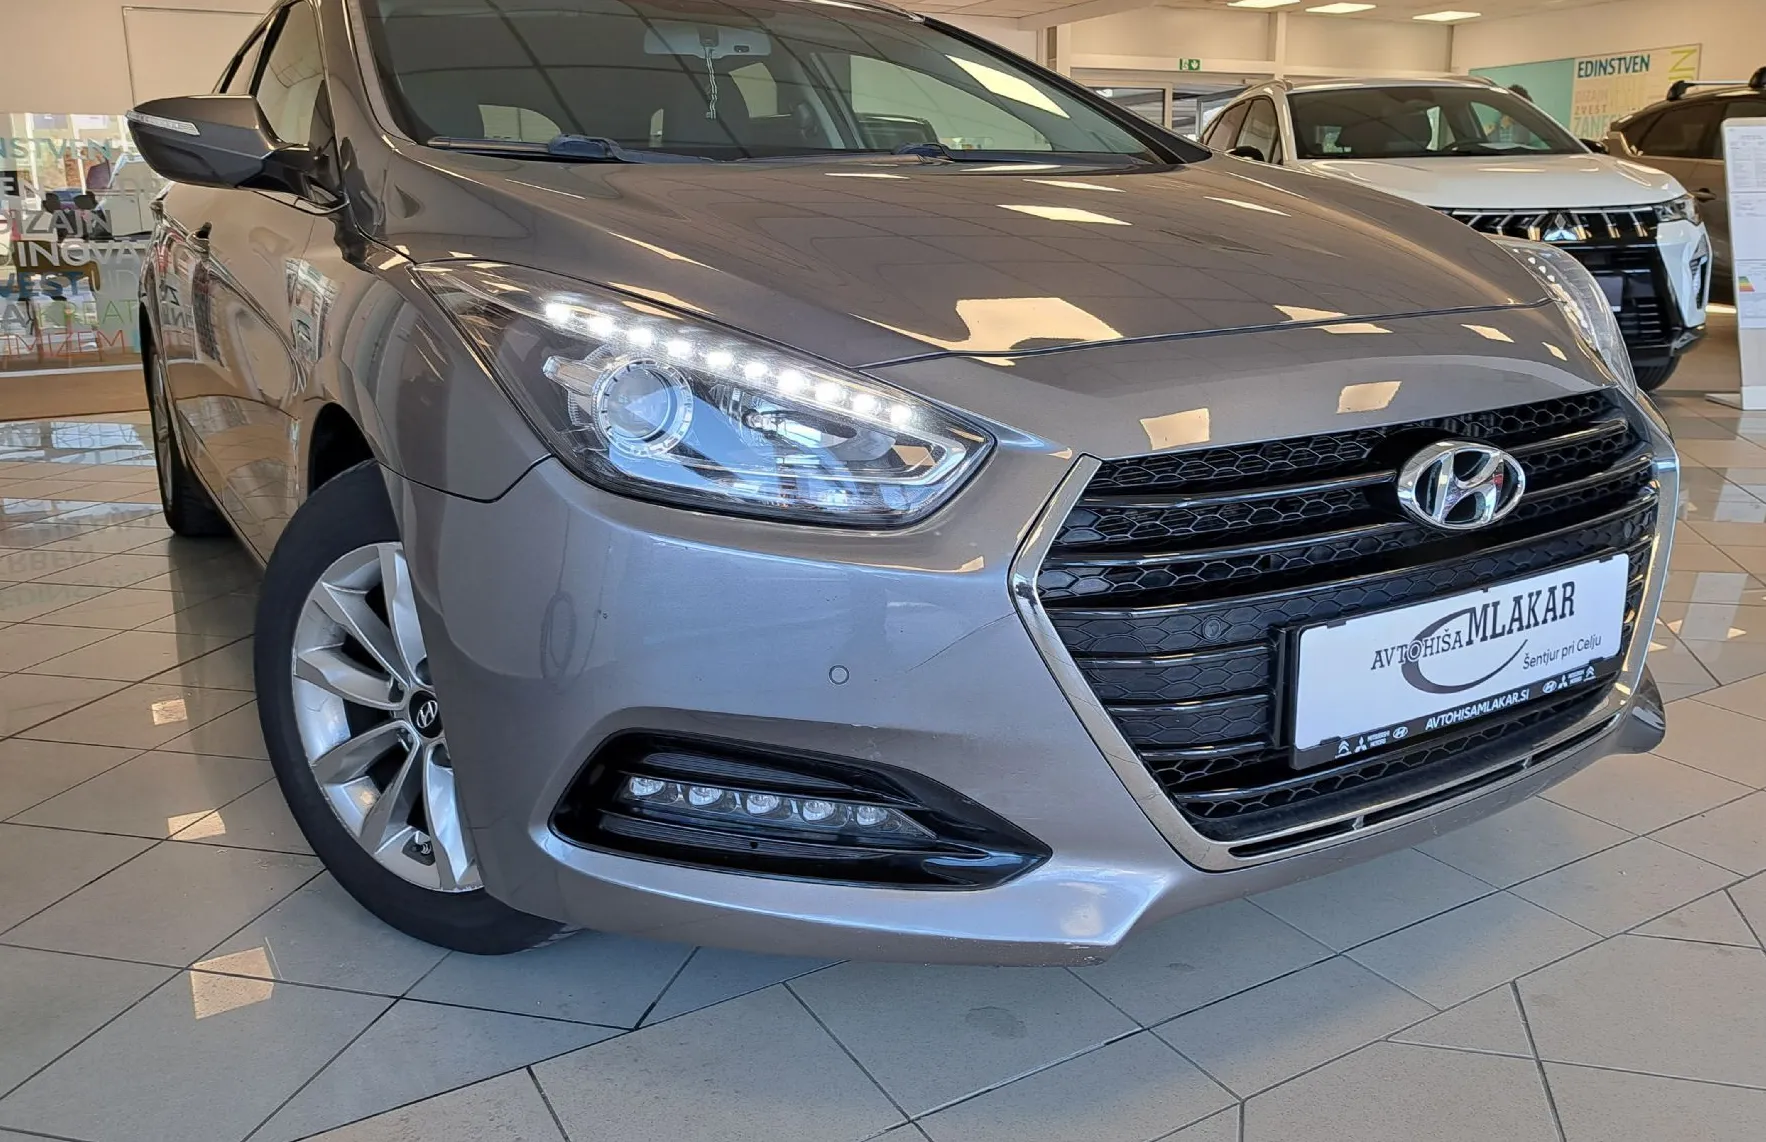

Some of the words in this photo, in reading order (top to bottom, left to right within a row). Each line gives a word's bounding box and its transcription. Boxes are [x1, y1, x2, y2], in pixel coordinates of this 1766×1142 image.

[1577, 54, 1651, 78] EDINSTVEN
[0, 137, 112, 161] STVEN
[1371, 628, 1464, 671] AVTOHIŠA
[1465, 580, 1577, 647] MLAKAR
[1522, 651, 1560, 671] Šentjur
[1561, 644, 1575, 660] pri
[1576, 635, 1603, 654] Celju
[1425, 688, 1529, 730] AVTOHISAMLAKAR.SI
